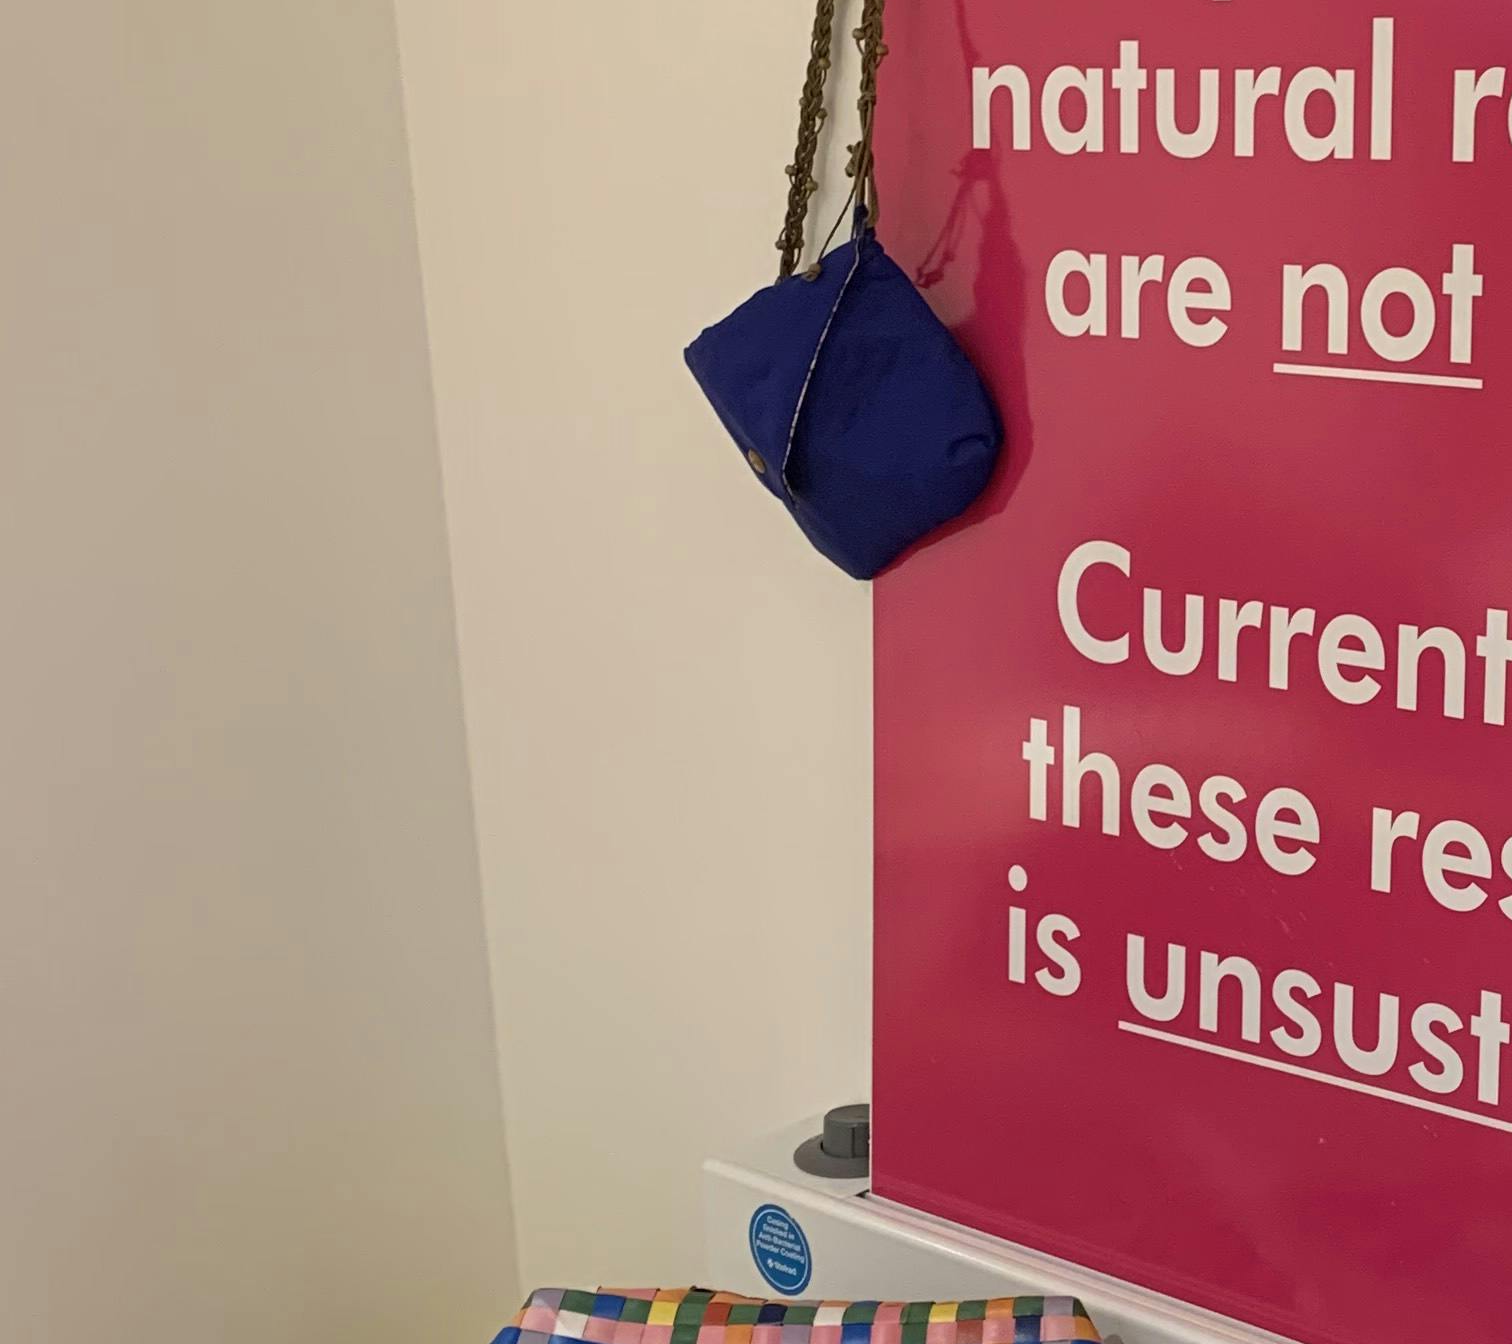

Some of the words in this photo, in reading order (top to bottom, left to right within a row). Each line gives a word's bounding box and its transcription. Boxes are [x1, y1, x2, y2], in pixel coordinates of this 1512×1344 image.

[973, 18, 1393, 160] natural
[1046, 250, 1231, 346] are
[1283, 244, 1482, 363] not
[1023, 706, 1319, 875] these
[1009, 865, 1080, 995] is
